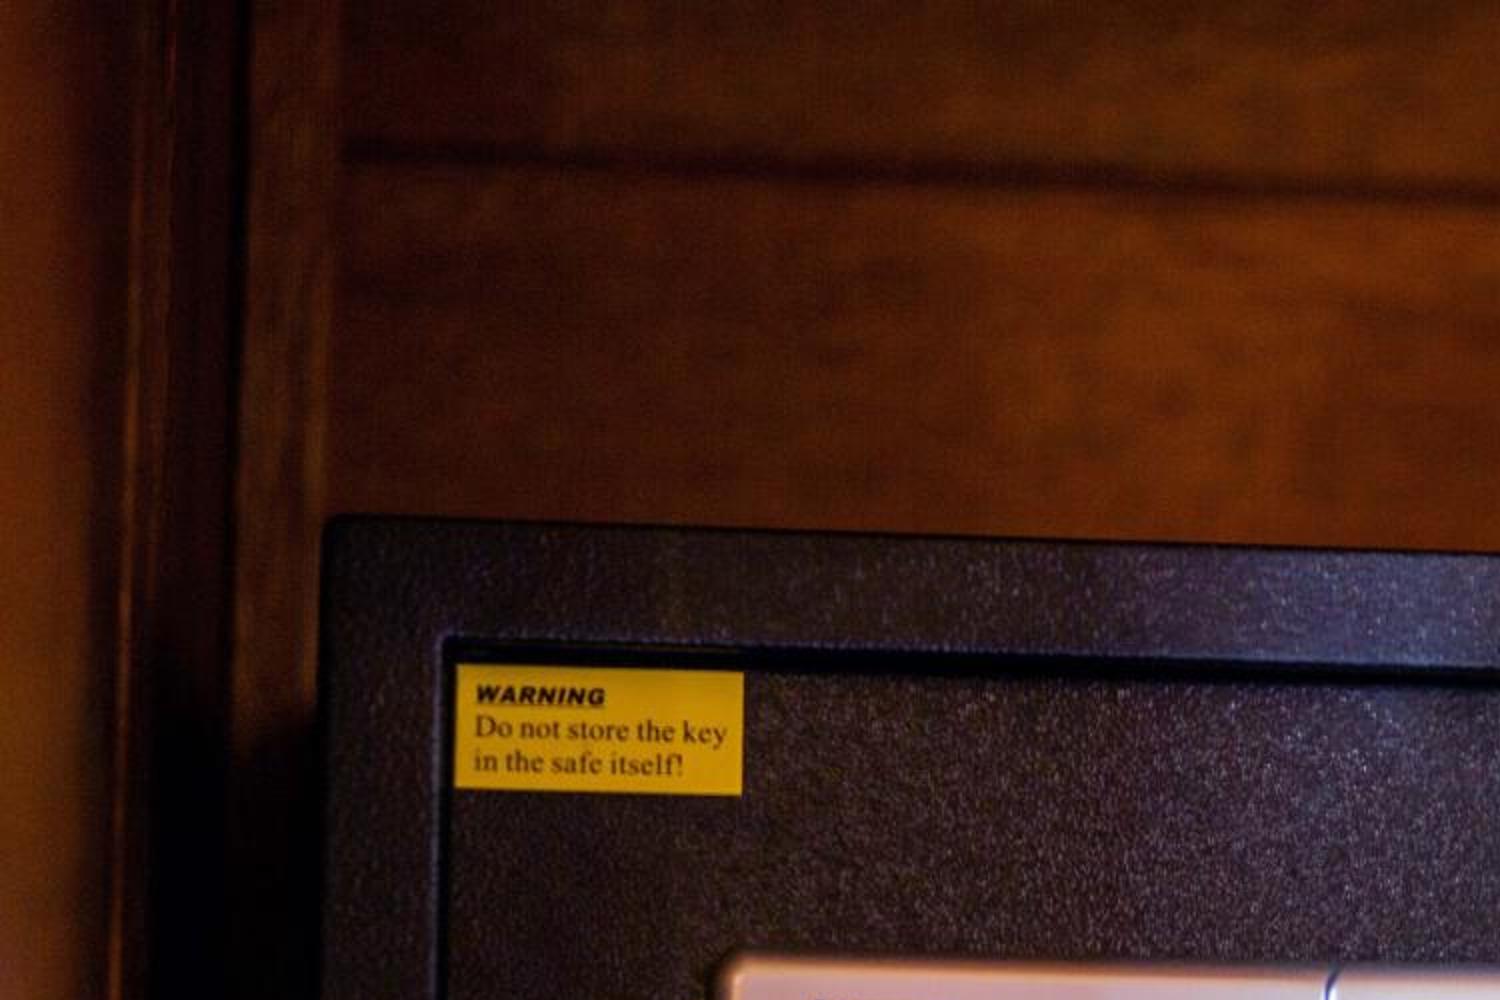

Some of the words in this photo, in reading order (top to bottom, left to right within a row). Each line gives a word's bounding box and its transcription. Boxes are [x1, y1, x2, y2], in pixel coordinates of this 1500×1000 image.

[476, 684, 606, 706] WARNING
[475, 715, 512, 738] Do
[520, 720, 560, 741] not
[568, 720, 630, 742] store
[637, 719, 675, 744] the
[683, 720, 727, 750] key
[474, 749, 498, 773] in
[505, 750, 544, 774] the
[551, 752, 603, 775] safe
[610, 753, 684, 777] itself!
